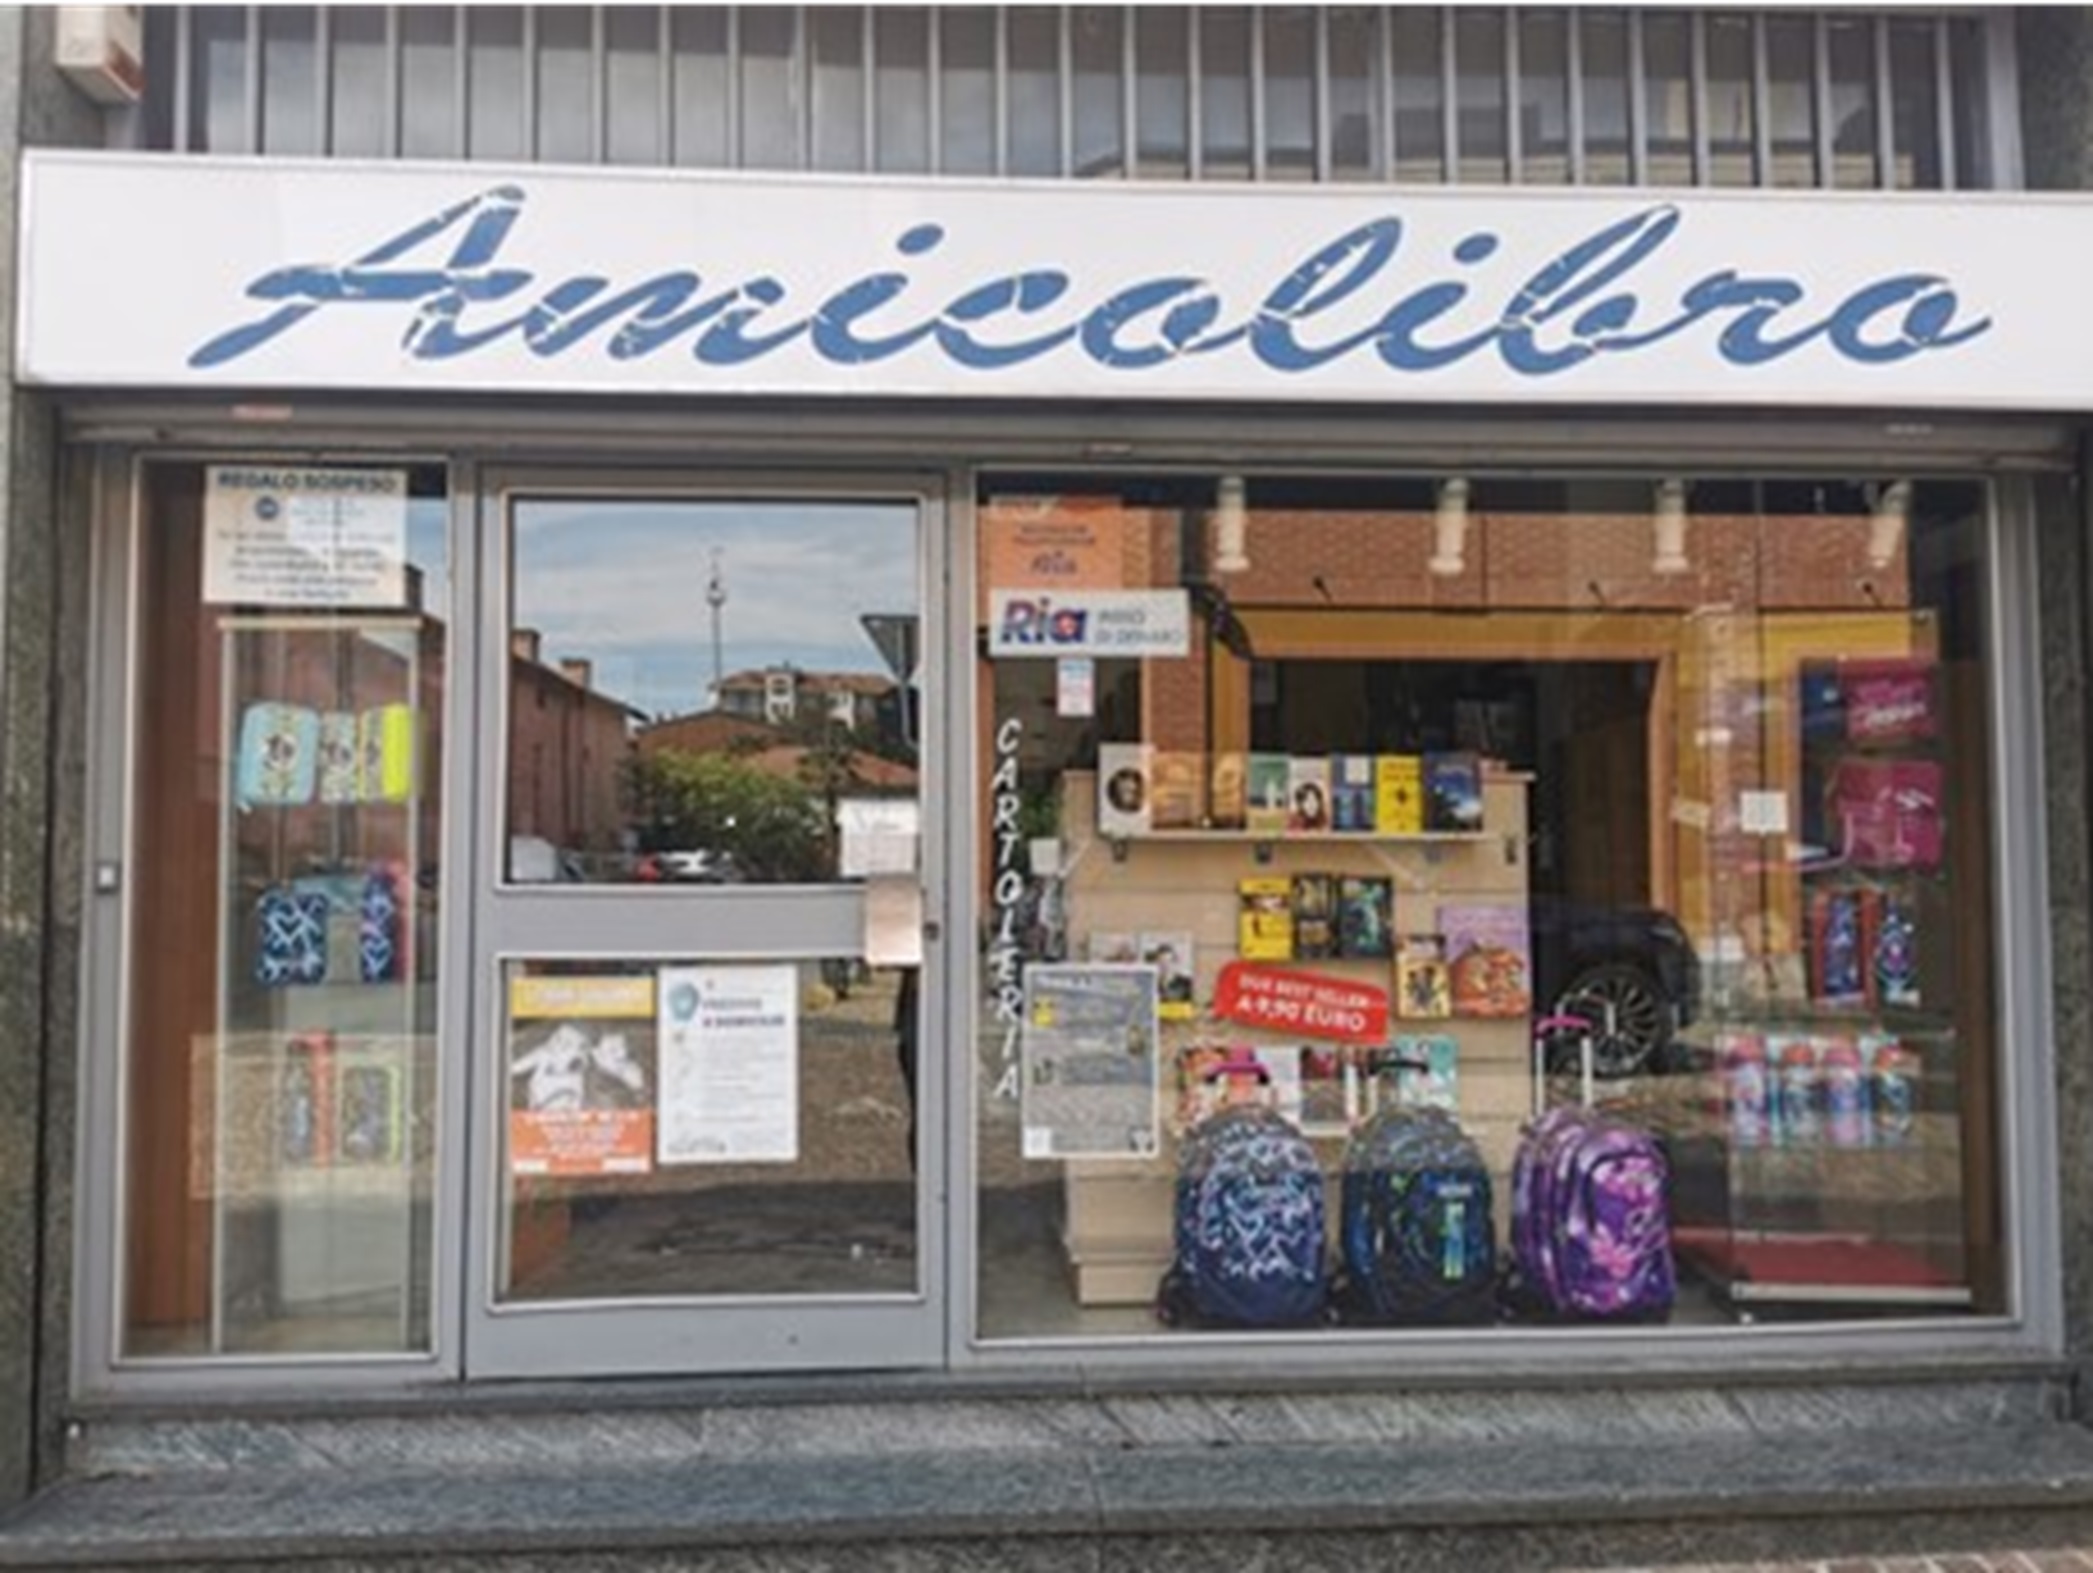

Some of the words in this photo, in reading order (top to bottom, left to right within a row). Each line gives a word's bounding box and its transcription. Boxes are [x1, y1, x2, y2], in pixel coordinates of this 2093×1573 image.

[188, 184, 1992, 377] Amicolibro
[218, 470, 299, 488] REGALO
[304, 474, 396, 493] SOSPESO
[1001, 596, 1087, 643] Ria
[990, 718, 1022, 1098] CARTOLERIA
[1237, 994, 1251, 1010] A
[1257, 996, 1299, 1021] 9,90
[1304, 1003, 1366, 1032] EURO
